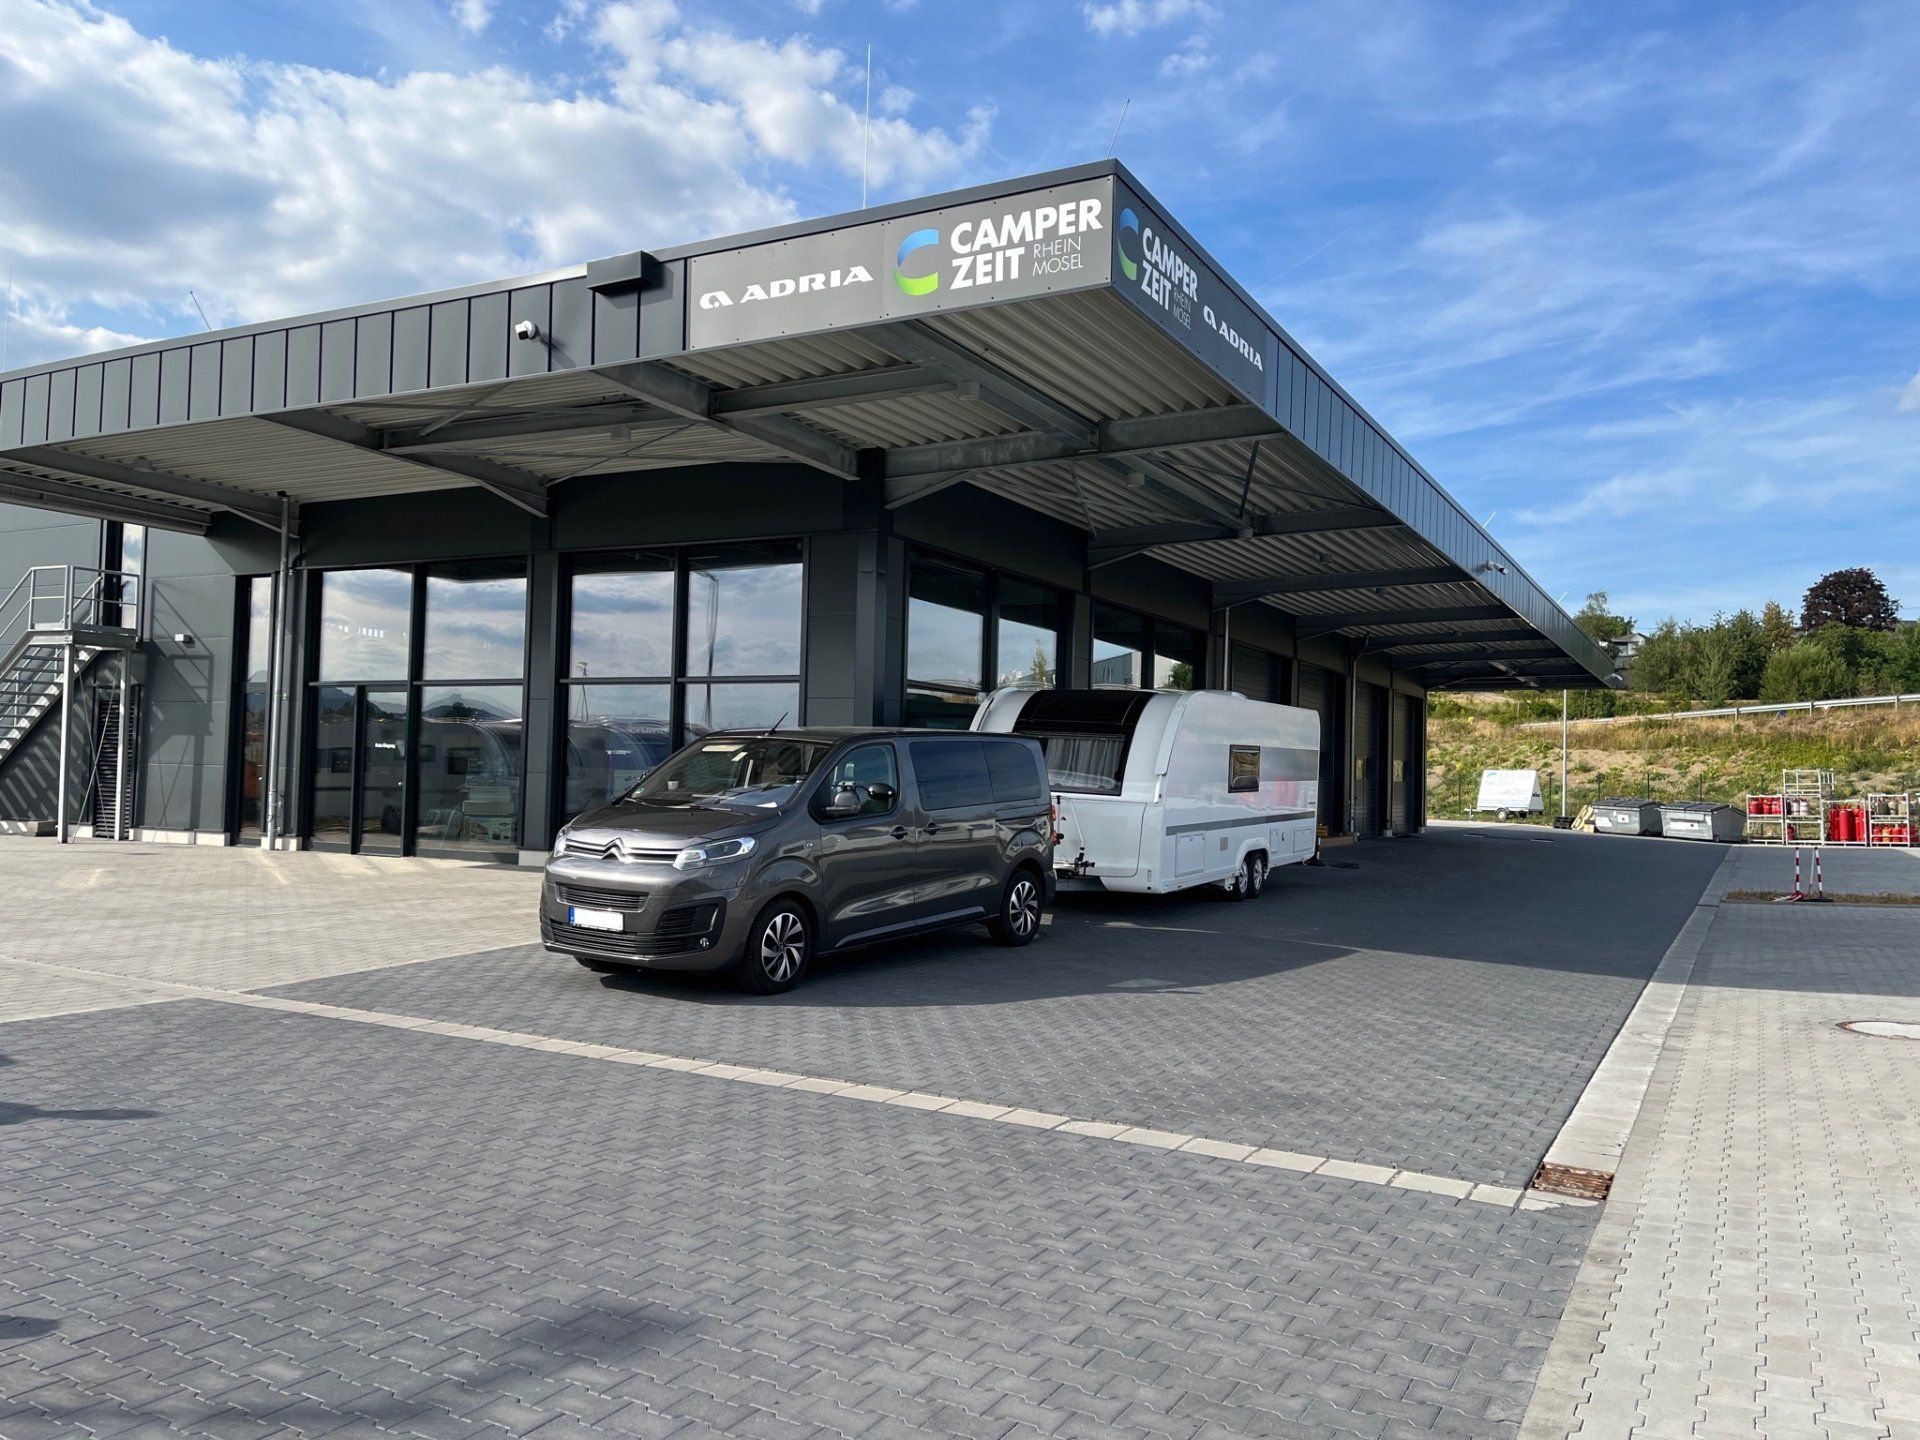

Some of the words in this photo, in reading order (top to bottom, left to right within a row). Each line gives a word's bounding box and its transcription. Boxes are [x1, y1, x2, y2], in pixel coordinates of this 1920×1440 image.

[951, 198, 1104, 254] CAMPER
[1032, 253, 1084, 277] MOSEL
[1033, 236, 1082, 259] RHEIN
[1142, 227, 1198, 303] CAMPER
[739, 265, 874, 304] ADRIA
[950, 247, 1025, 290] ZEIT
[1141, 260, 1172, 310] ZEIT
[1172, 305, 1192, 330] MOSEL
[1173, 287, 1192, 312] RHEIN
[1219, 320, 1263, 372] ADRIA
